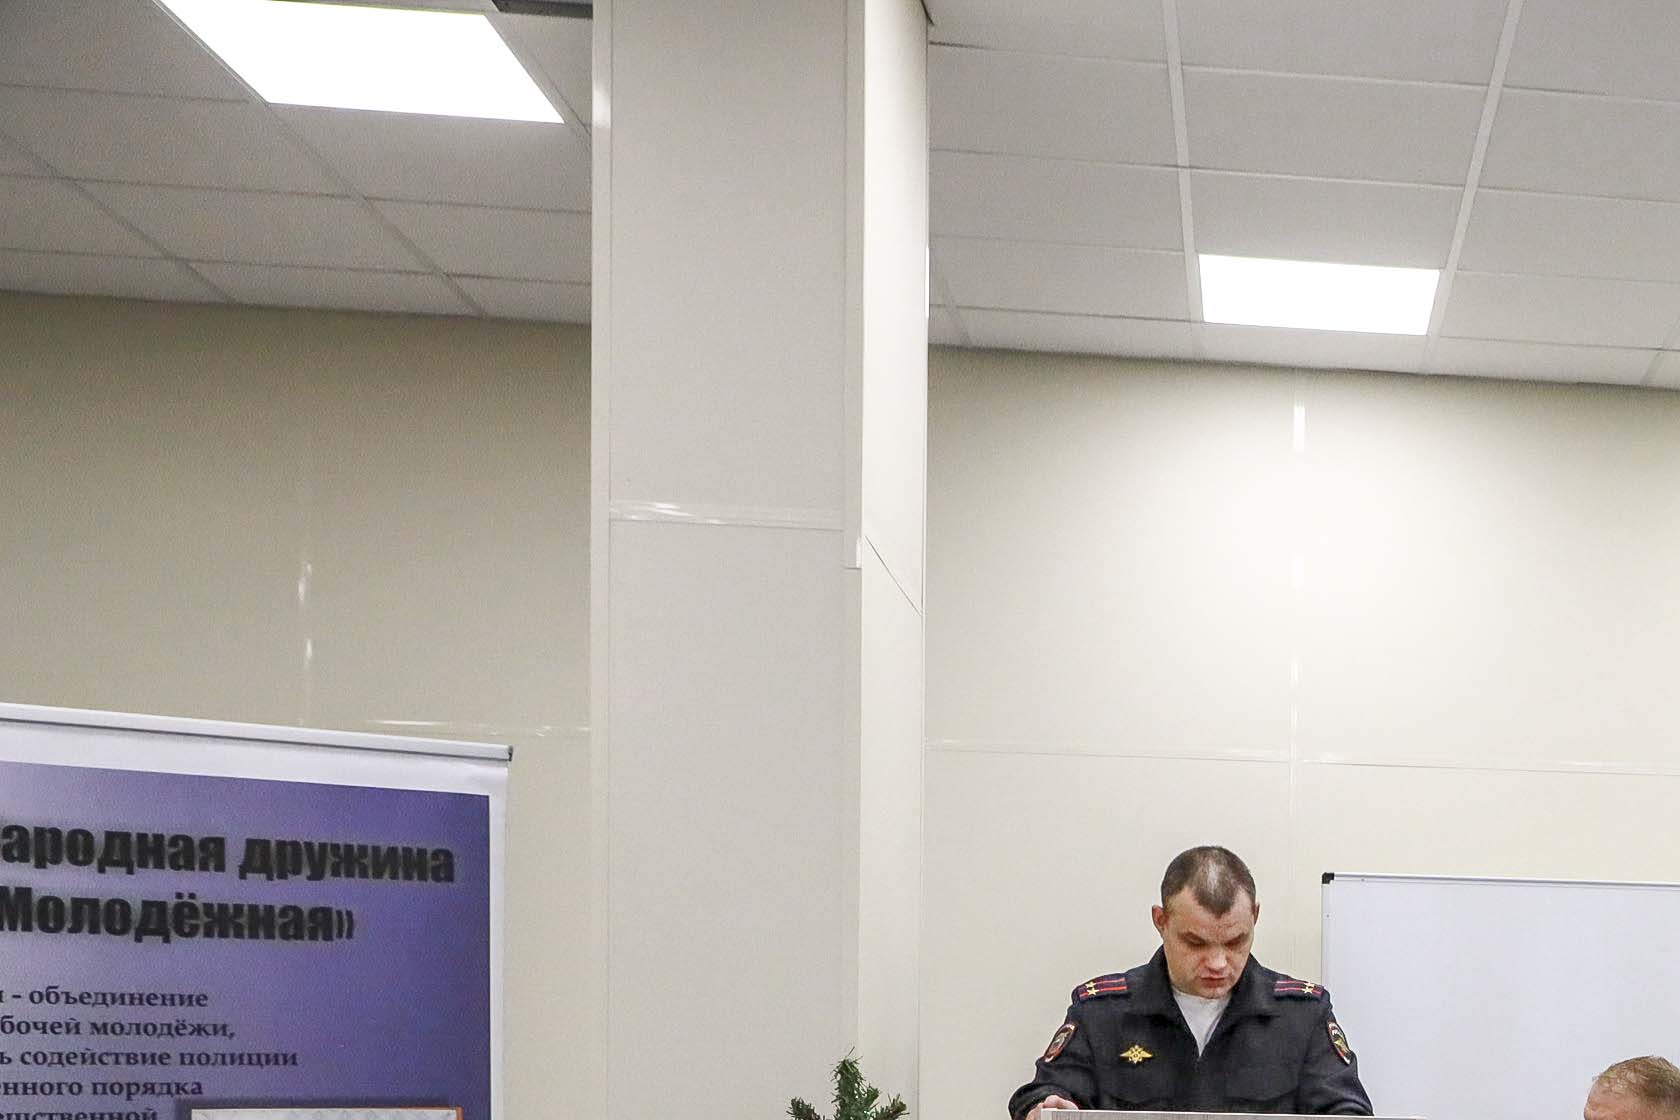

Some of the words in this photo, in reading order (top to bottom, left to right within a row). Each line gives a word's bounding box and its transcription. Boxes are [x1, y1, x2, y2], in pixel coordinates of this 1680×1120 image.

[1, 824, 227, 875] ародная
[238, 836, 456, 883] дружина
[29, 985, 209, 1008] объединение
[1, 1015, 82, 1036] бочей
[90, 1019, 236, 1038] молодёжи,
[20, 1048, 172, 1067] содействие
[179, 1051, 299, 1068] полиции
[0, 1080, 83, 1097] нного
[92, 1080, 204, 1101] порядка
